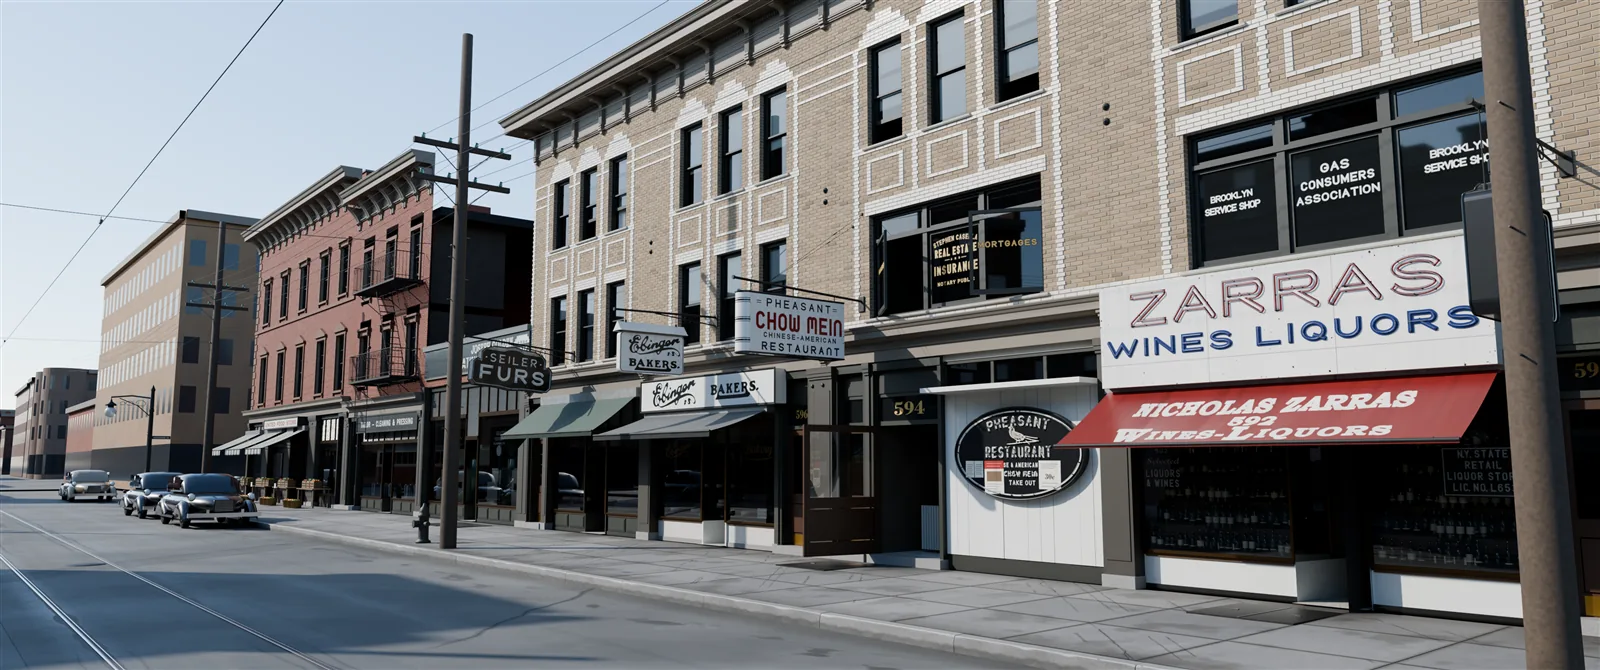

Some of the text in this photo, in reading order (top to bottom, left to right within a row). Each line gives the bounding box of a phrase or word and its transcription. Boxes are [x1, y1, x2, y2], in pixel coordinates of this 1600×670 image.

[1429, 138, 1489, 159] BROOKLYN
[1319, 158, 1350, 173] GAS
[1424, 152, 1490, 174] SERVICE SHO
[1300, 168, 1375, 192] CONSUMERS
[1210, 188, 1253, 204] BROOKLYN
[1296, 182, 1381, 207] ASSOCIATION
[1204, 198, 1261, 217] SERVICE SHOP
[933, 235, 954, 249] STEPHEN
[934, 241, 977, 259] REAL ESTAE
[977, 238, 1037, 249] MORTGAGES
[937, 276, 976, 287] NOTARY PUBL
[1129, 253, 1445, 328] ZARRAS
[766, 297, 831, 314] PHEASANT
[755, 310, 843, 338] CHOW MEIN
[1107, 305, 1480, 359] WINES LIQUORS
[763, 331, 837, 344] CHINESE-AMERICAN
[761, 341, 840, 357] RESTAURANT
[490, 353, 538, 368] SEILER
[629, 358, 680, 372] BAKERS.
[479, 363, 544, 387] FURS
[710, 380, 759, 400] BAKERS.
[893, 400, 925, 416] 594
[1132, 390, 1418, 418] NICHOLAS ZARRAS
[795, 409, 808, 420] 596
[1227, 415, 1277, 427] 592
[986, 415, 1050, 432] PHEASANT
[985, 445, 1051, 458] RESTAURANT
[1474, 449, 1509, 459] STATE
[1464, 460, 1502, 470] RETAIL
[1145, 469, 1181, 478] LIQUORS
[1446, 471, 1484, 481] LIQUOR
[1154, 479, 1180, 488] WINES
[1452, 482, 1471, 492] LIC.
[1490, 483, 1514, 493] L65
